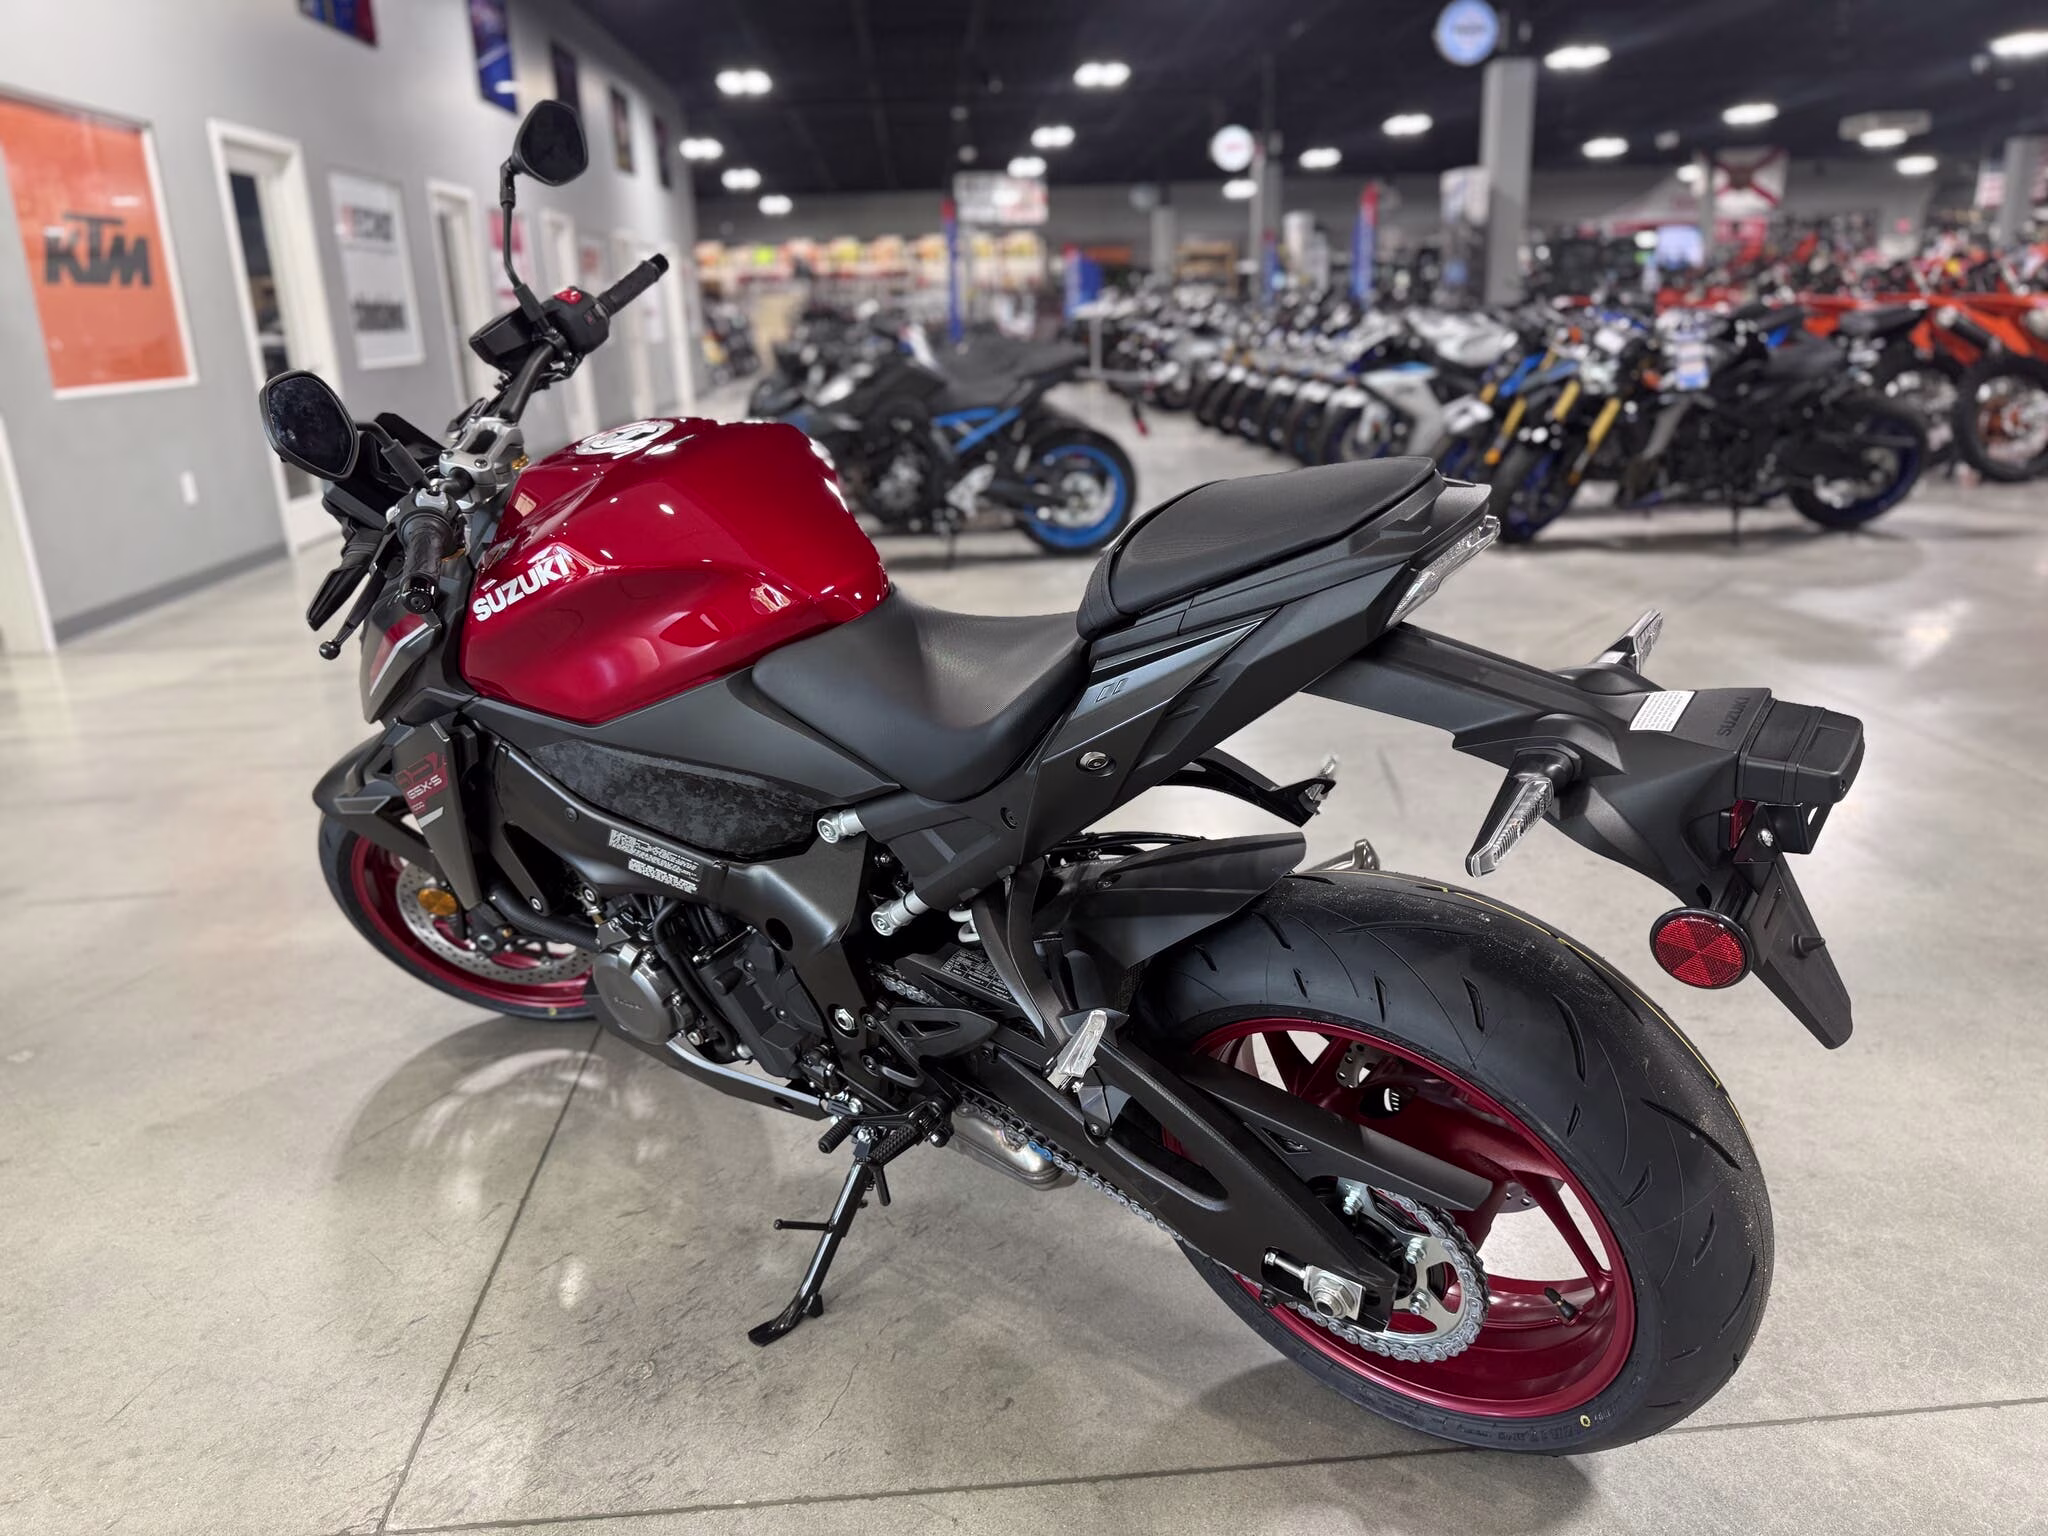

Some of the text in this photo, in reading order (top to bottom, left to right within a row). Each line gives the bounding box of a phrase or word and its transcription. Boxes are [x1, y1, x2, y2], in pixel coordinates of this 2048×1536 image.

[45, 210, 151, 286] KTM
[472, 553, 571, 622] SUZUKI
[1717, 696, 1751, 737] SUZUKI
